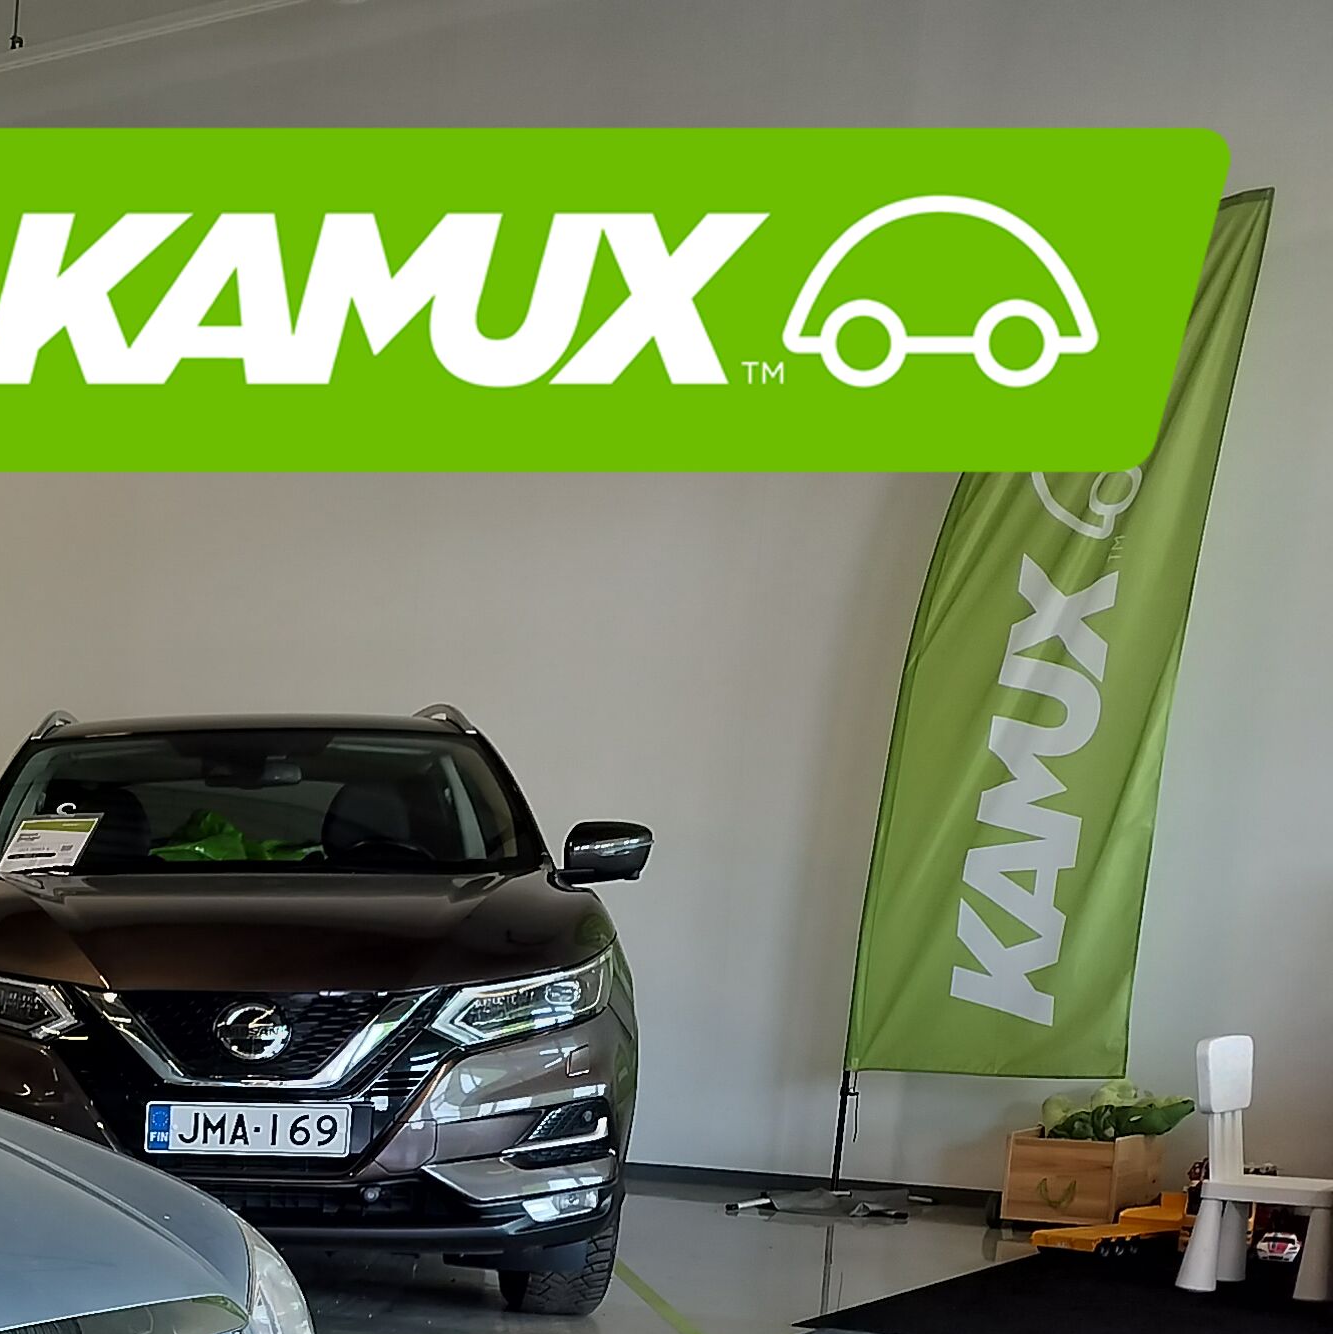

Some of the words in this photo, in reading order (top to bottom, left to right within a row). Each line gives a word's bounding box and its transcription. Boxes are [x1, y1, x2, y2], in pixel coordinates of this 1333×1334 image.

[949, 552, 1120, 1027] KAMUX
[149, 1131, 169, 1143] FIN
[177, 1111, 339, 1148] JMA-169
